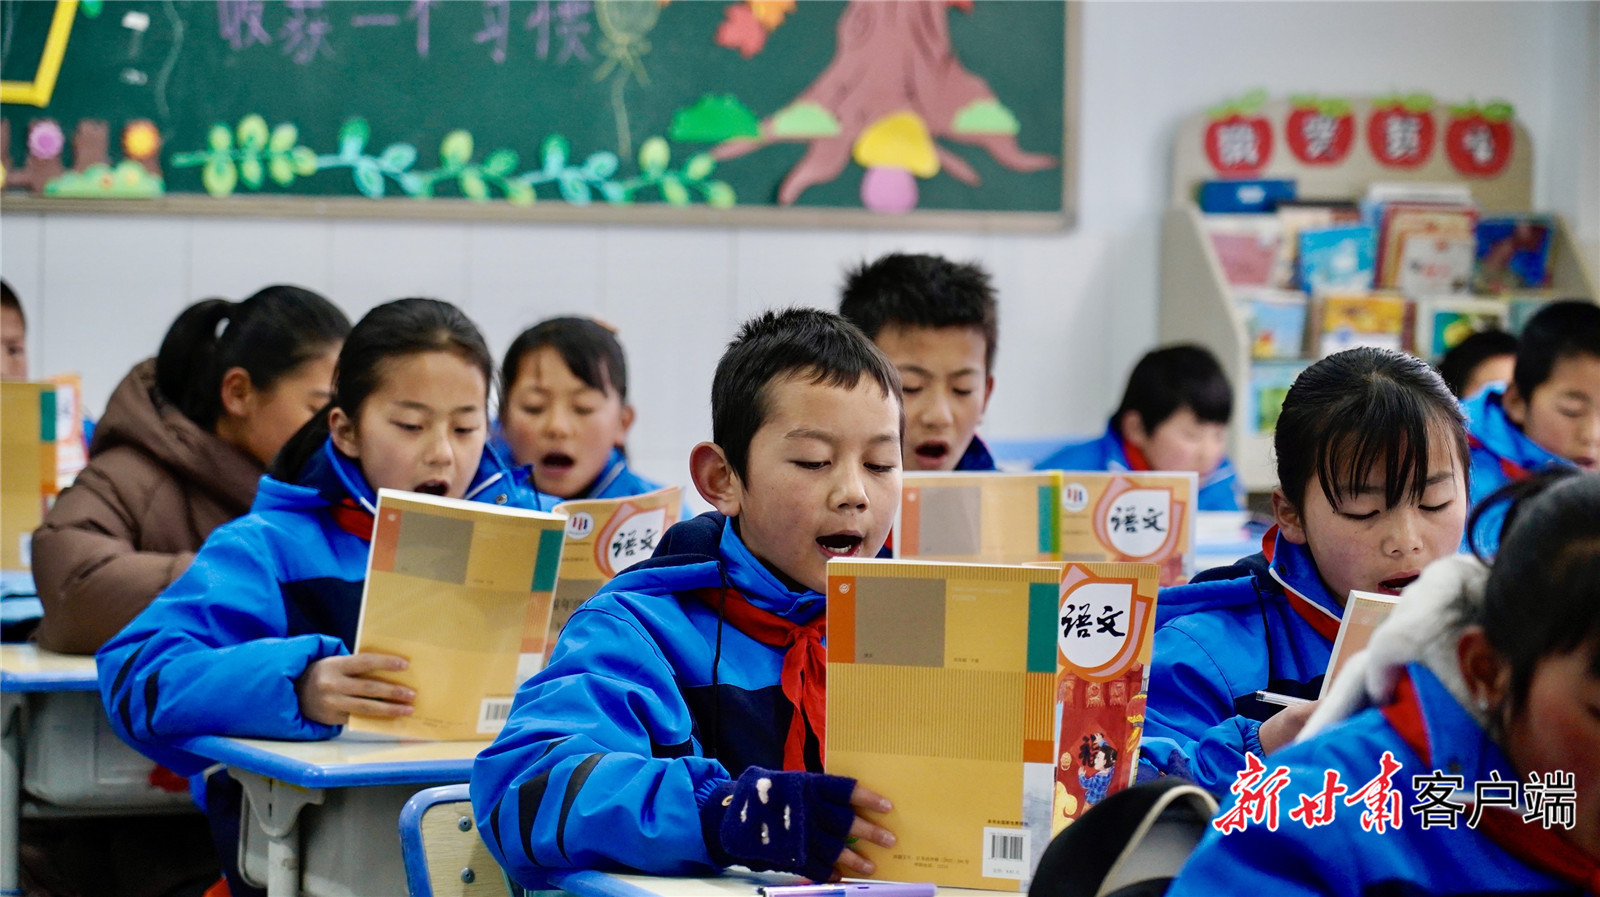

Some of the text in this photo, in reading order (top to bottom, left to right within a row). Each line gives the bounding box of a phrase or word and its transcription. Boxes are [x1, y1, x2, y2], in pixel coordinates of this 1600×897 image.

[1110, 506, 1167, 533] 语文
[612, 528, 659, 558] 语文
[1060, 603, 1126, 639] 语文
